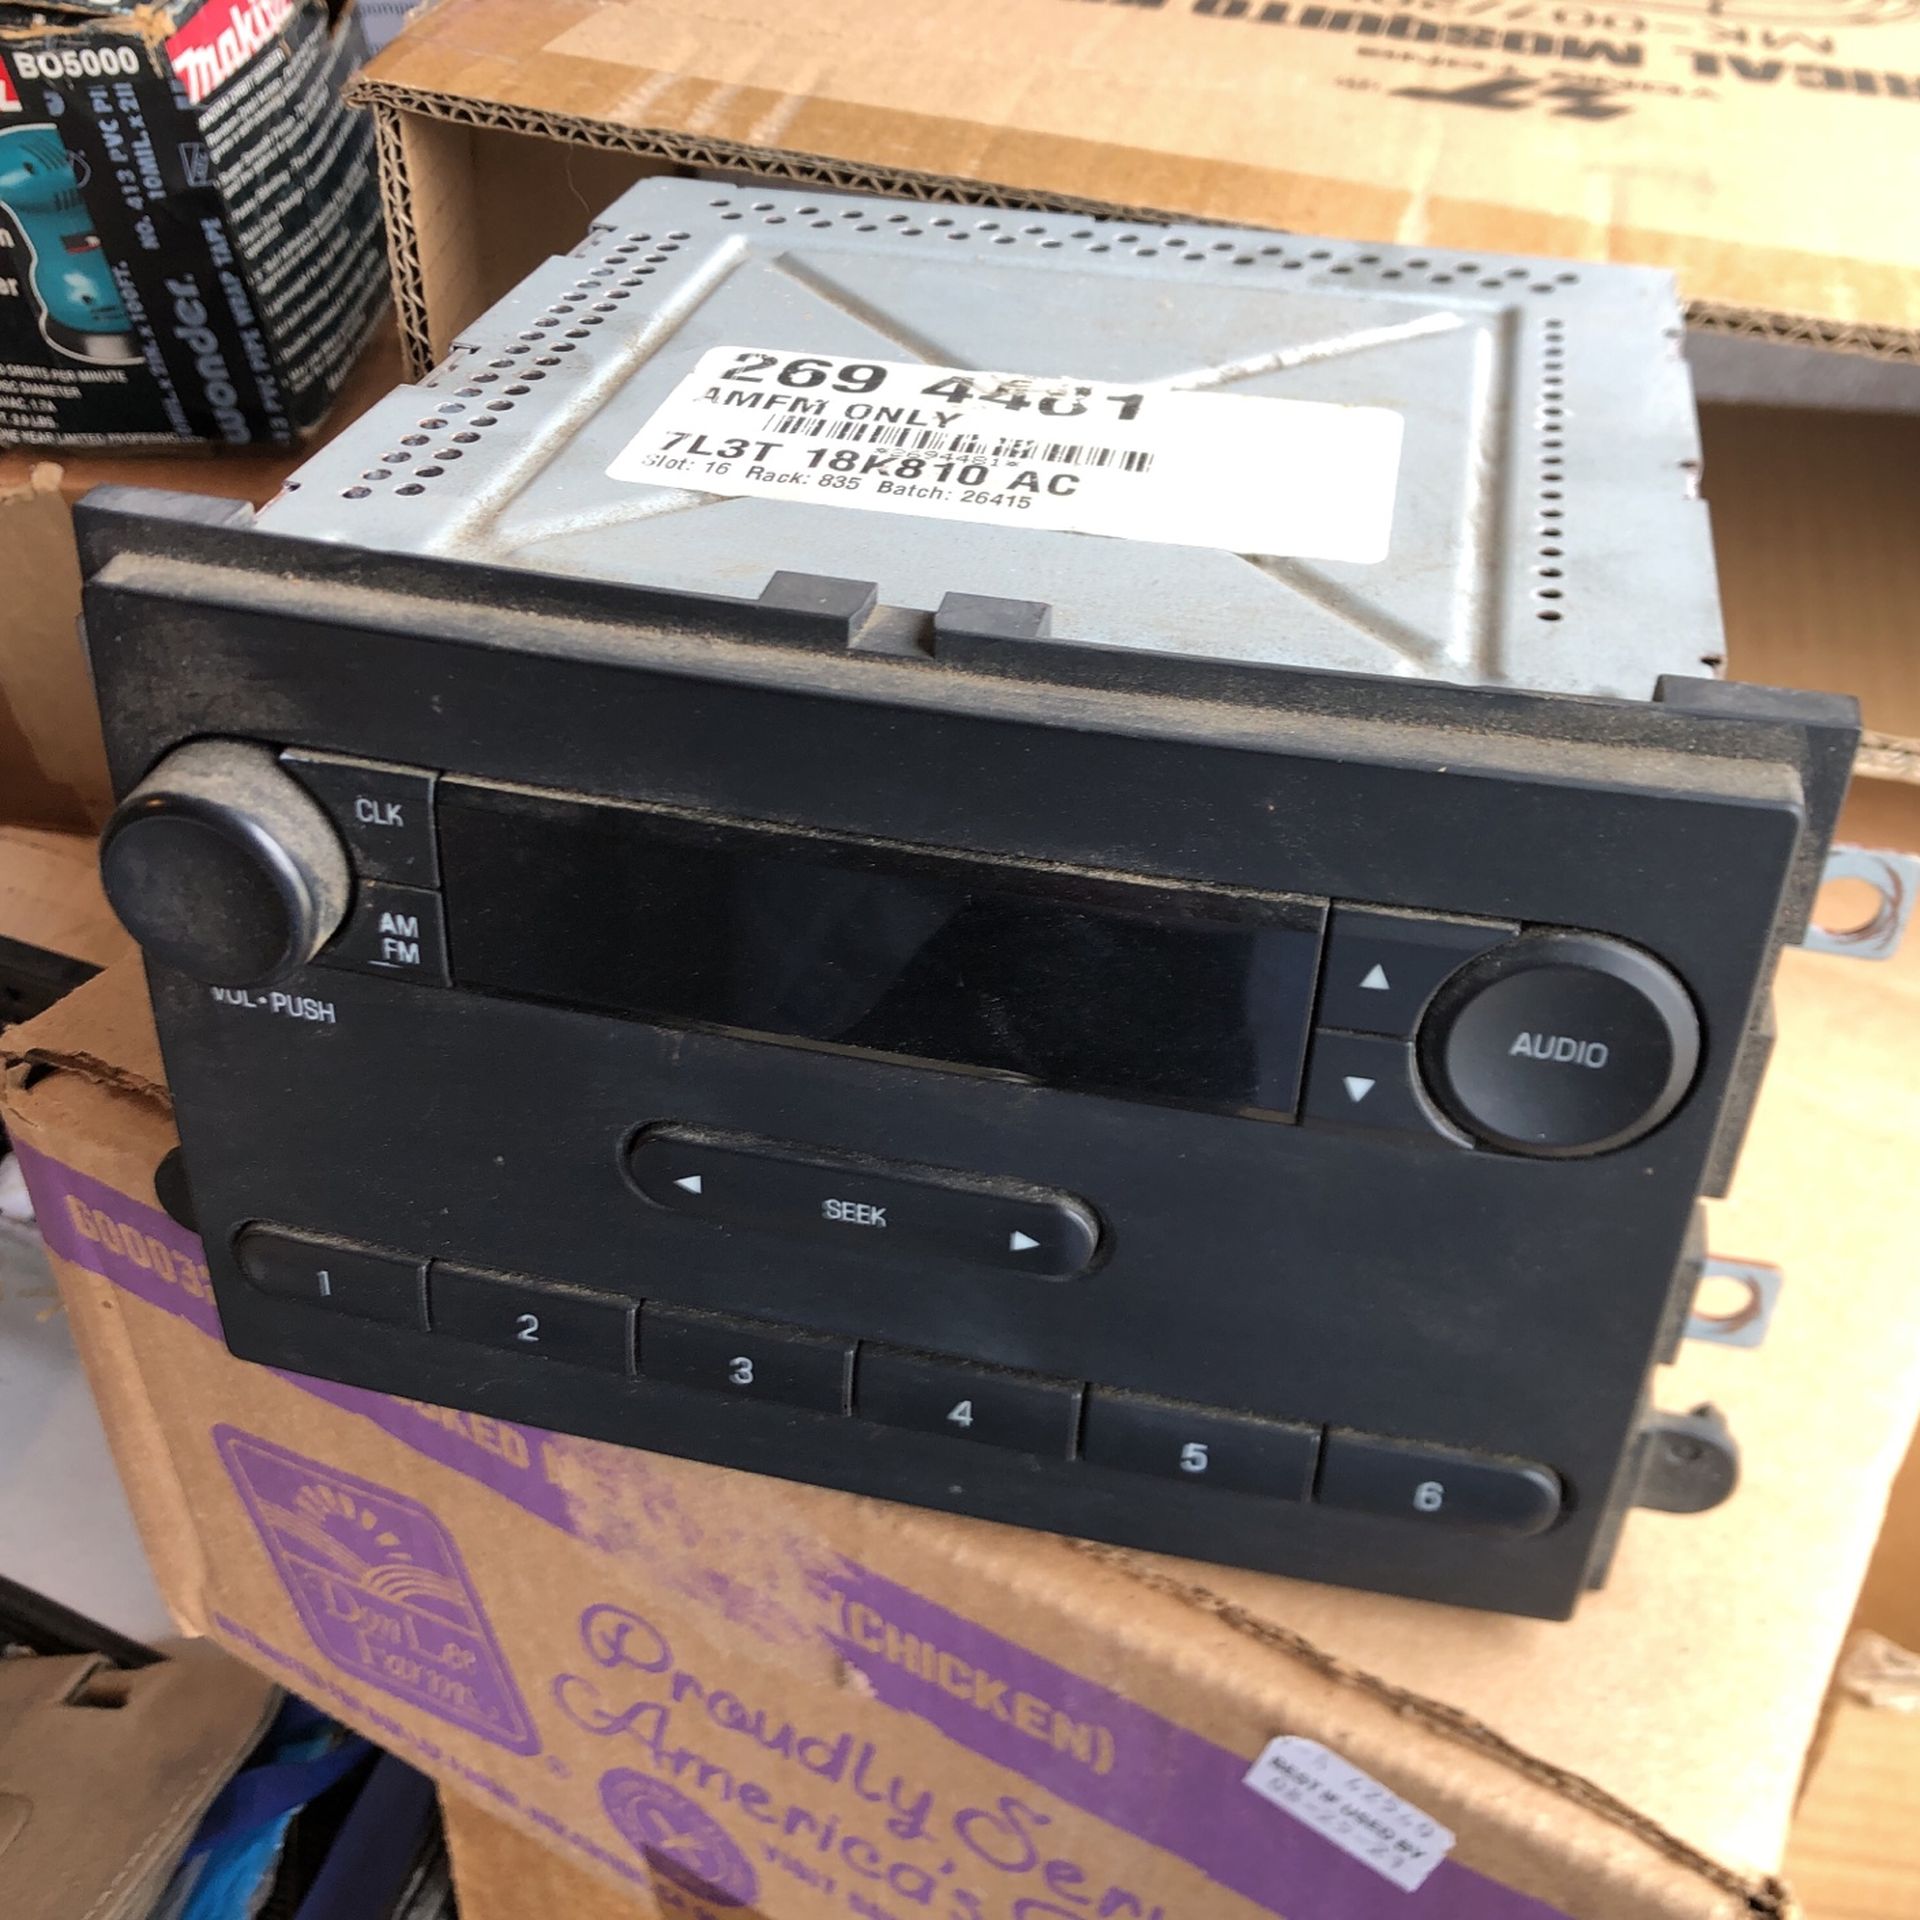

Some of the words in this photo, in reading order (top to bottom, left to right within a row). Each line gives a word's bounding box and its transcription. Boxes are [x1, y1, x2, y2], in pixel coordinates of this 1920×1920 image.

[12, 46, 140, 79] BO5000
[720, 353, 888, 393] 269
[697, 387, 830, 416] AMFM
[844, 403, 964, 428] ONLY
[660, 431, 784, 462] 7L3T
[806, 448, 990, 487] 18K810
[1007, 470, 1080, 496] AC
[705, 462, 732, 475] 16
[745, 466, 811, 485] Rack:
[818, 474, 863, 490] 835
[876, 481, 953, 501] Batch:
[960, 490, 1032, 509] 26415
[356, 798, 404, 827] CLK
[379, 912, 419, 938] AM
[382, 938, 421, 964] FM
[1509, 1031, 1608, 1069] AUDIO
[822, 1200, 887, 1228] SEEK
[317, 1271, 331, 1297] 1
[517, 1314, 539, 1342] 2
[729, 1357, 754, 1385] 3
[947, 1401, 974, 1427] 4
[1180, 1442, 1209, 1473] 5
[1414, 1481, 1445, 1512] 6
[578, 1602, 938, 1842] Proudly
[550, 1673, 984, 1920] America's
